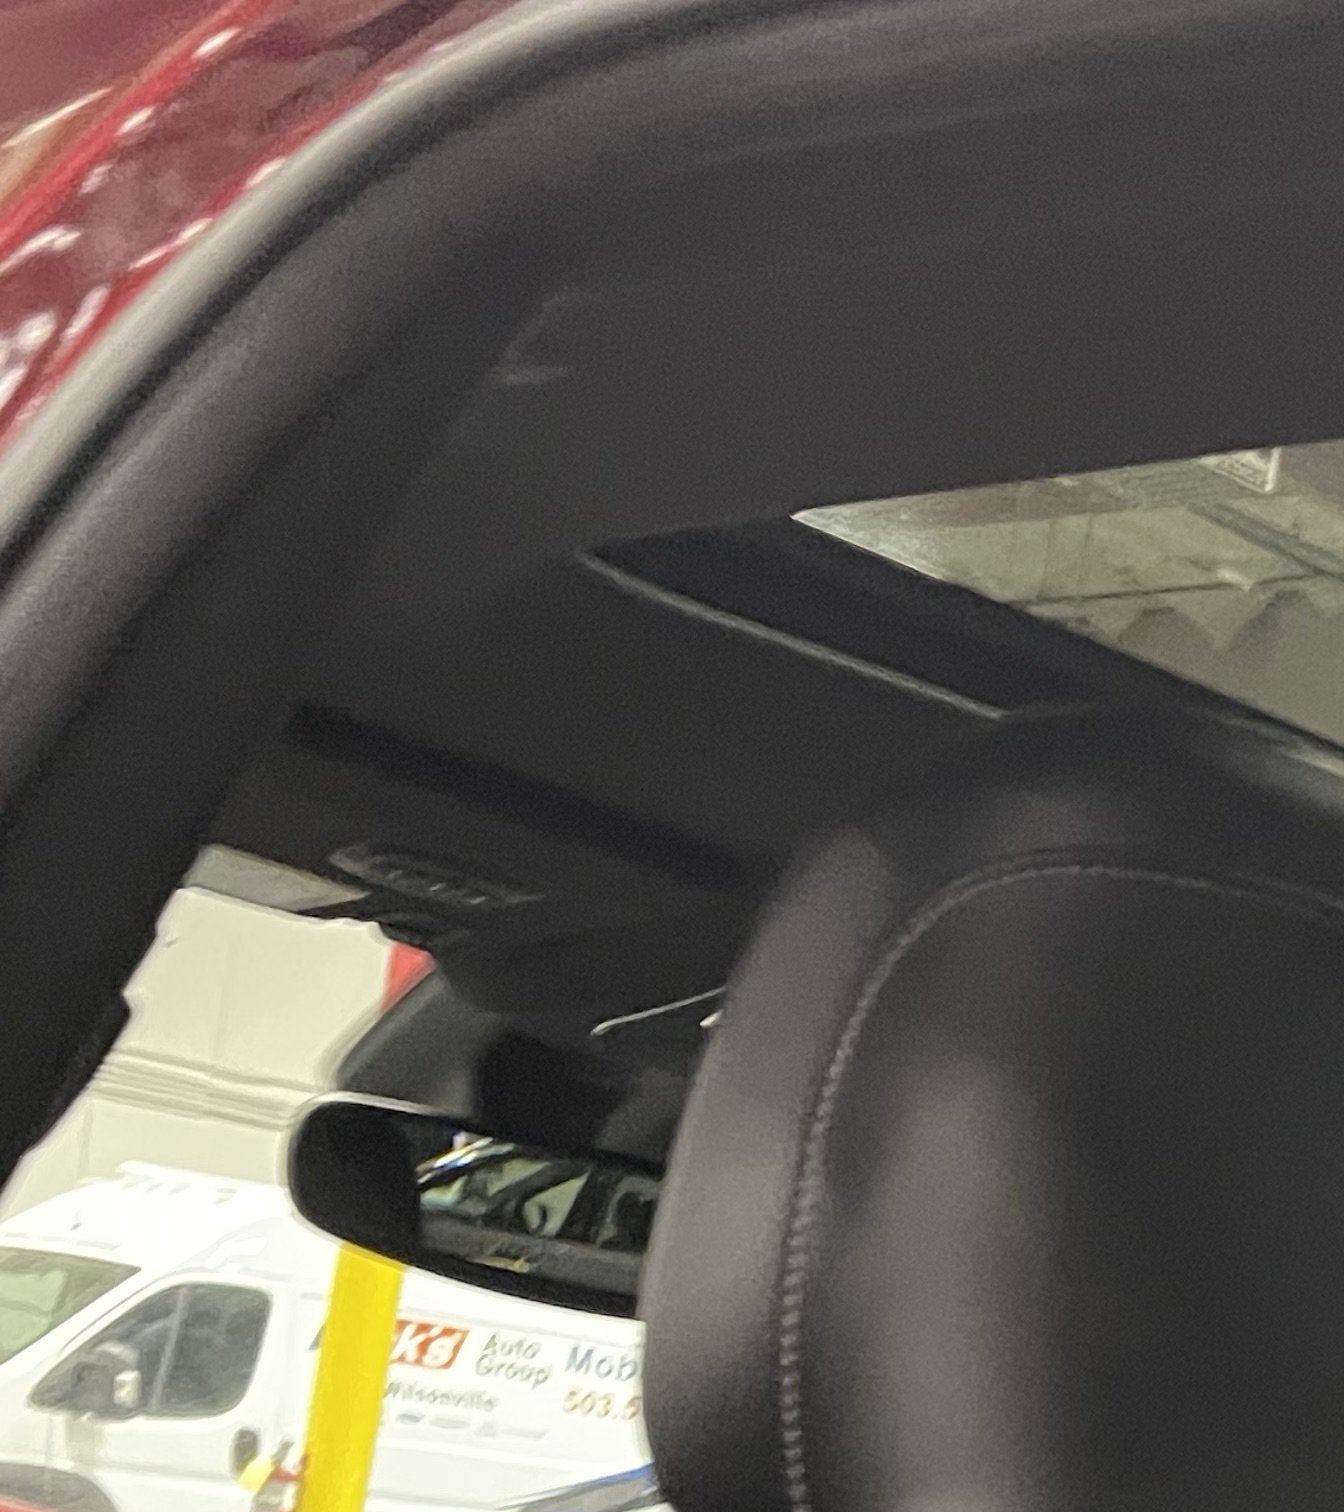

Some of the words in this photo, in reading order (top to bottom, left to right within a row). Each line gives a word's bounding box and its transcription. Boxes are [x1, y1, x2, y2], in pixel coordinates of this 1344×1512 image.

[482, 1331, 542, 1360] Auto
[564, 1344, 641, 1382] Mob
[475, 1352, 553, 1391] Group
